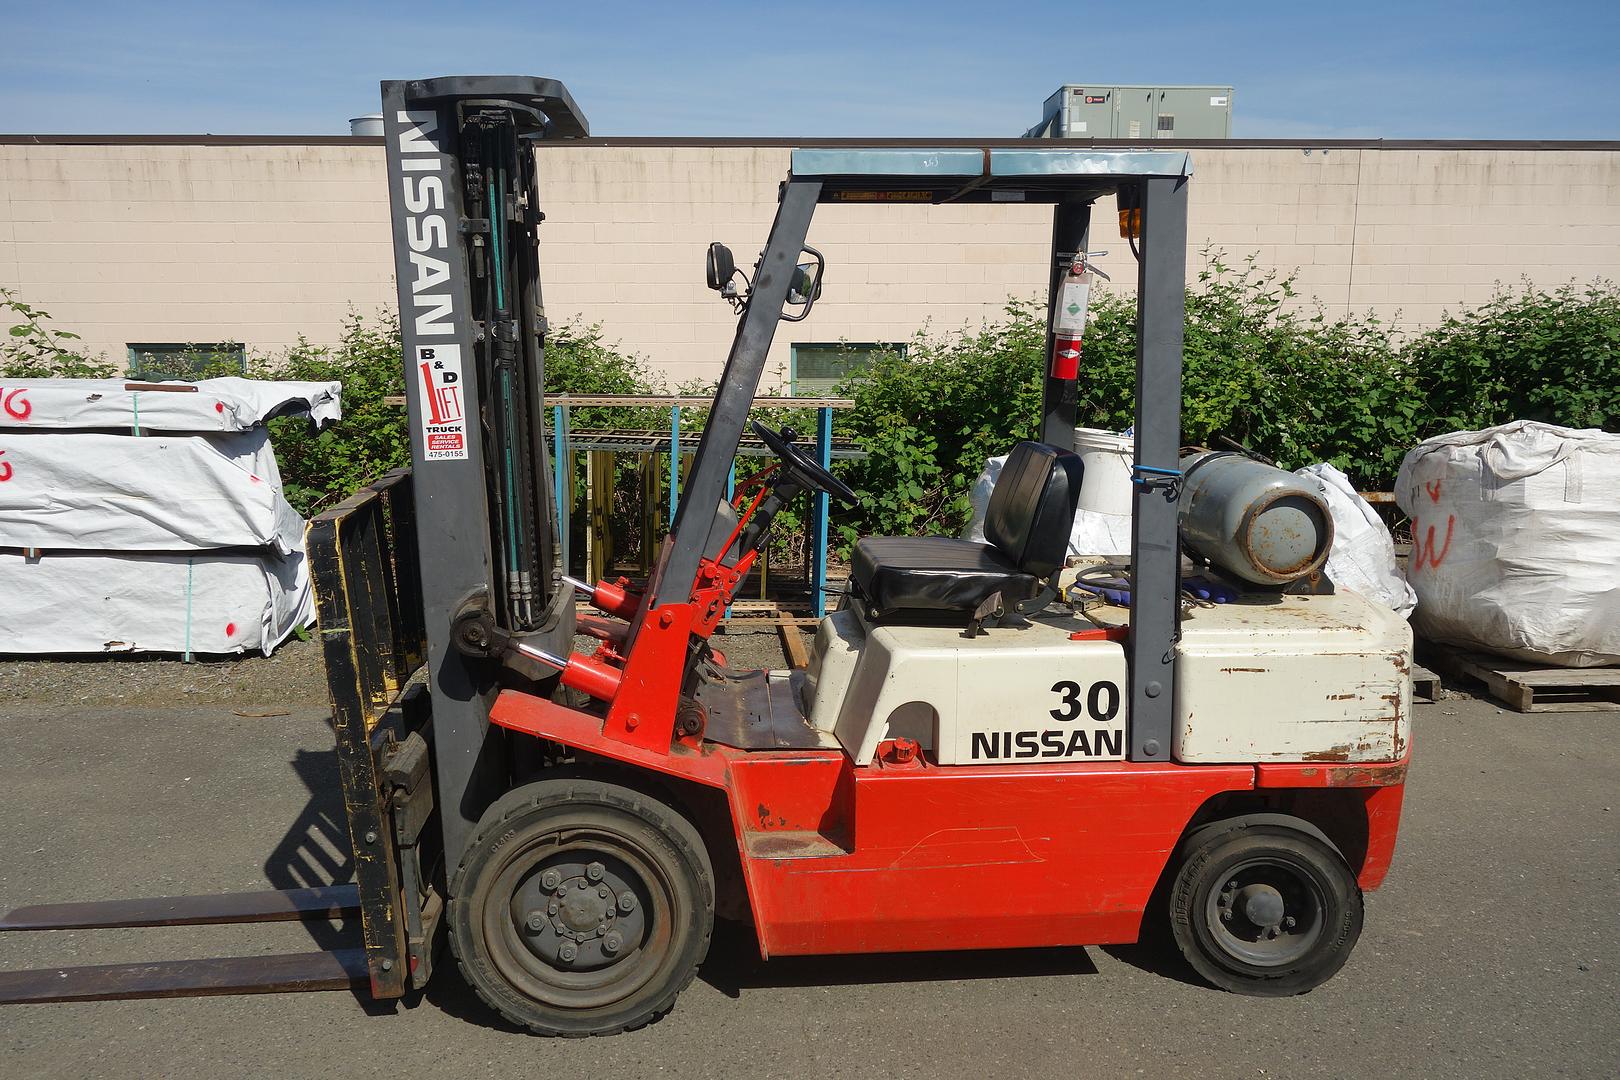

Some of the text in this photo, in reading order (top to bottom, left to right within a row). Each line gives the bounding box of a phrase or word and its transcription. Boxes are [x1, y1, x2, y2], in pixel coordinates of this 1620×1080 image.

[396, 110, 456, 336] NISSAN
[420, 348, 458, 384] B & D
[0, 387, 32, 422] 6
[1049, 680, 1120, 722] 30
[971, 729, 1123, 760] NISSAN
